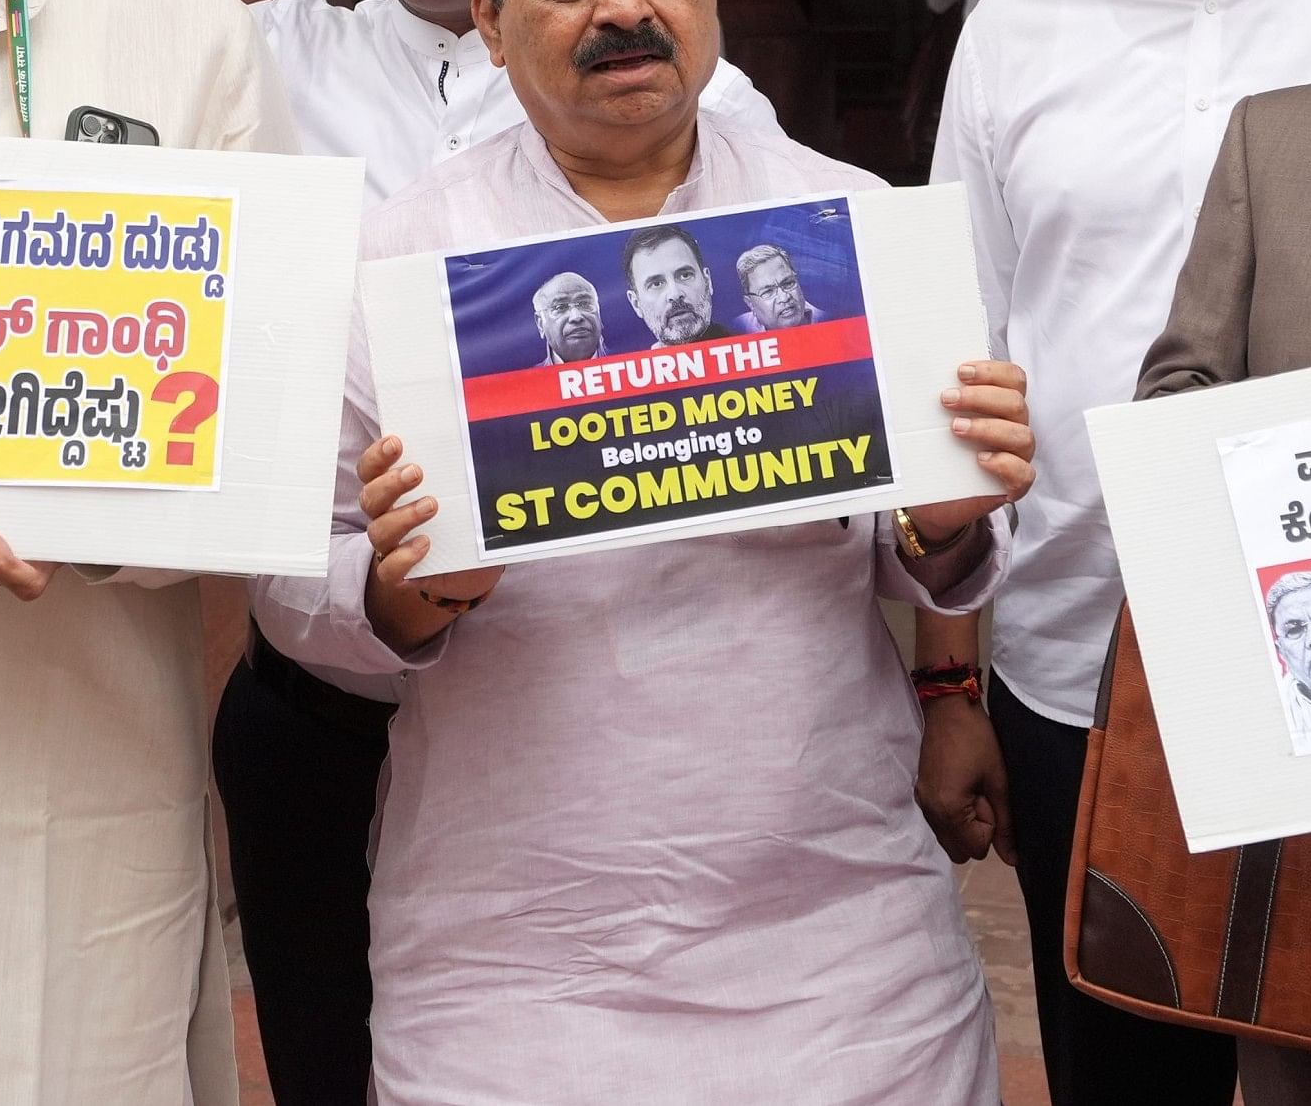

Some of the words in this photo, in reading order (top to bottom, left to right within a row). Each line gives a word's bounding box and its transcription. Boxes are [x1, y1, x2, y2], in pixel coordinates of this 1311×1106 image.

[123, 214, 225, 299] ದುಡ್ಡು
[45, 301, 188, 371] ಗಾಂಧಿ
[558, 354, 706, 399] RETURN
[708, 338, 781, 376] THE
[530, 402, 677, 451] LOOTED
[683, 377, 819, 426] MONEY
[601, 429, 733, 469] Belonging
[735, 425, 762, 446] to
[495, 487, 555, 532] ST
[564, 434, 872, 515] COMMUNITY
